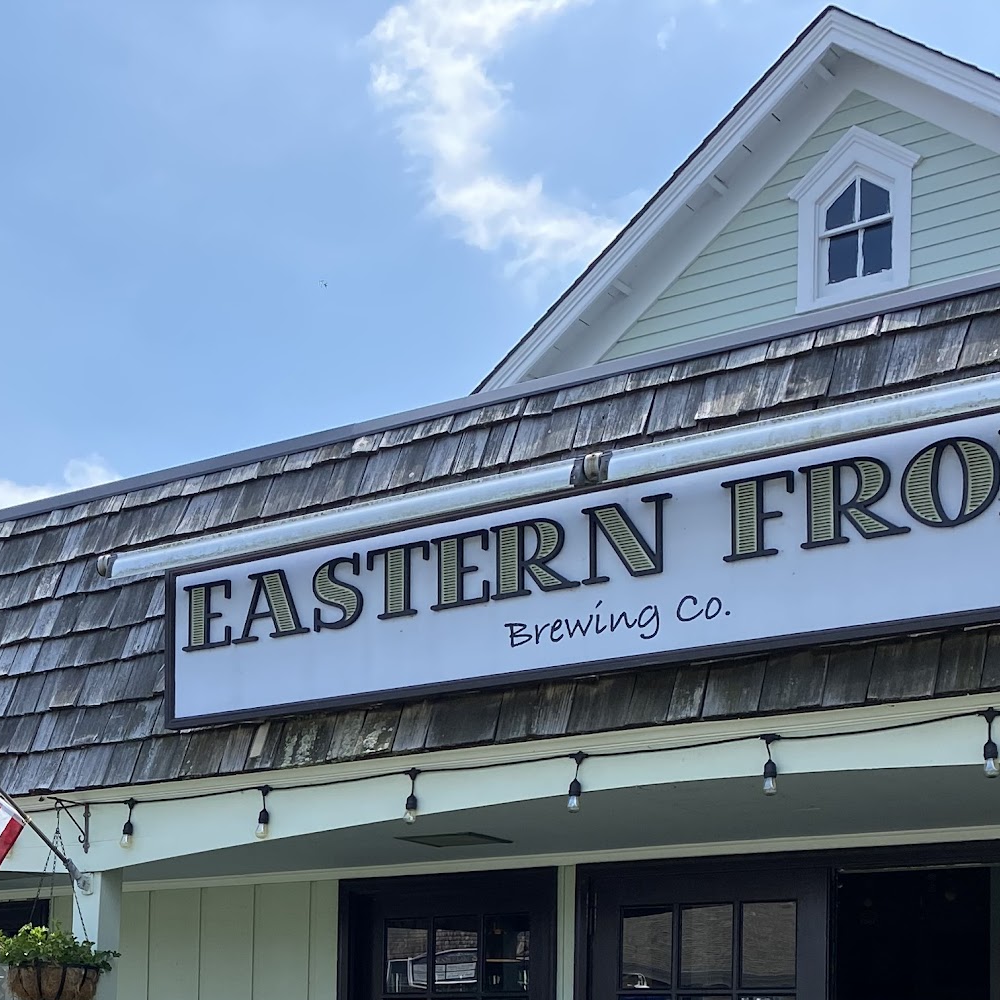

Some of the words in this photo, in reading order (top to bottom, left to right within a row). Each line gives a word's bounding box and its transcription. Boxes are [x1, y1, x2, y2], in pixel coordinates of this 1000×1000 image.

[182, 493, 673, 652] EASTERN
[721, 436, 1000, 562] FRO
[504, 600, 660, 648] Brewing
[676, 595, 731, 621] Co.
